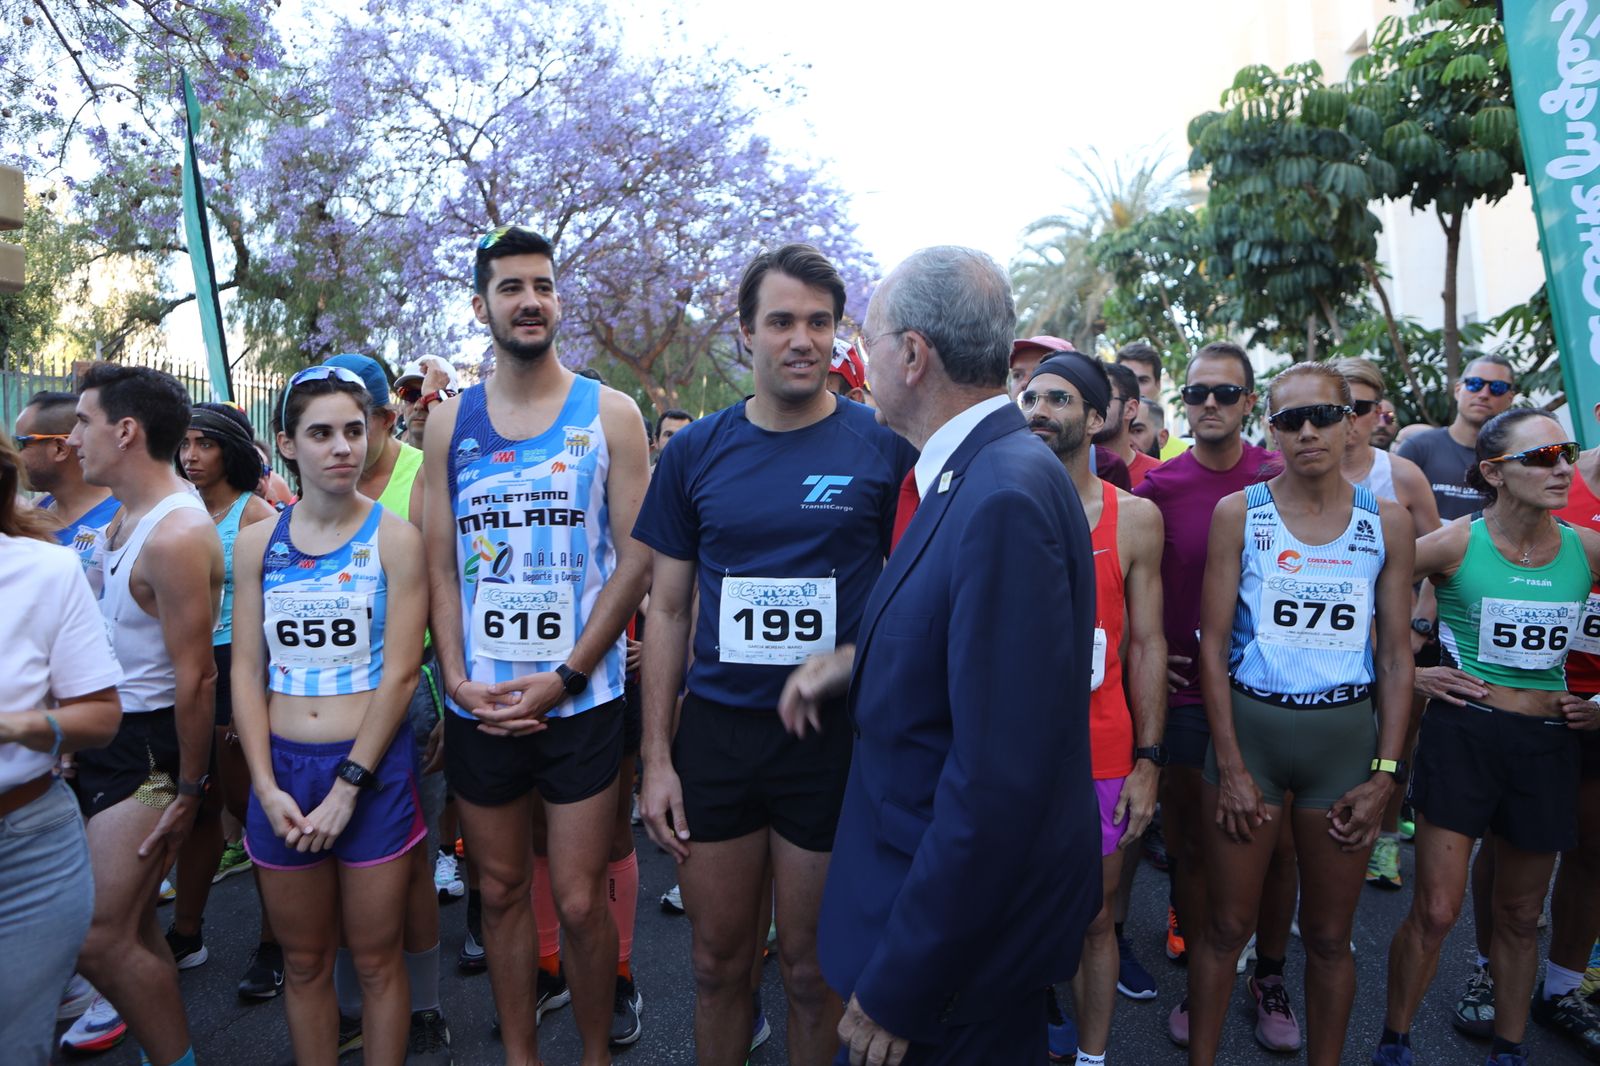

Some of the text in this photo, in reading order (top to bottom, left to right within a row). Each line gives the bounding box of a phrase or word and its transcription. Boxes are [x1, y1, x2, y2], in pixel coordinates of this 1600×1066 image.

[471, 490, 569, 506] ATLETISMO
[800, 504, 854, 512] TransitCargo
[458, 507, 586, 535] MÁLAGA
[484, 610, 561, 640] 616
[733, 608, 822, 642] 199
[1273, 599, 1356, 631] 676
[276, 618, 357, 648] 658
[1492, 622, 1568, 651] 586
[1281, 686, 1350, 705] NIKE
